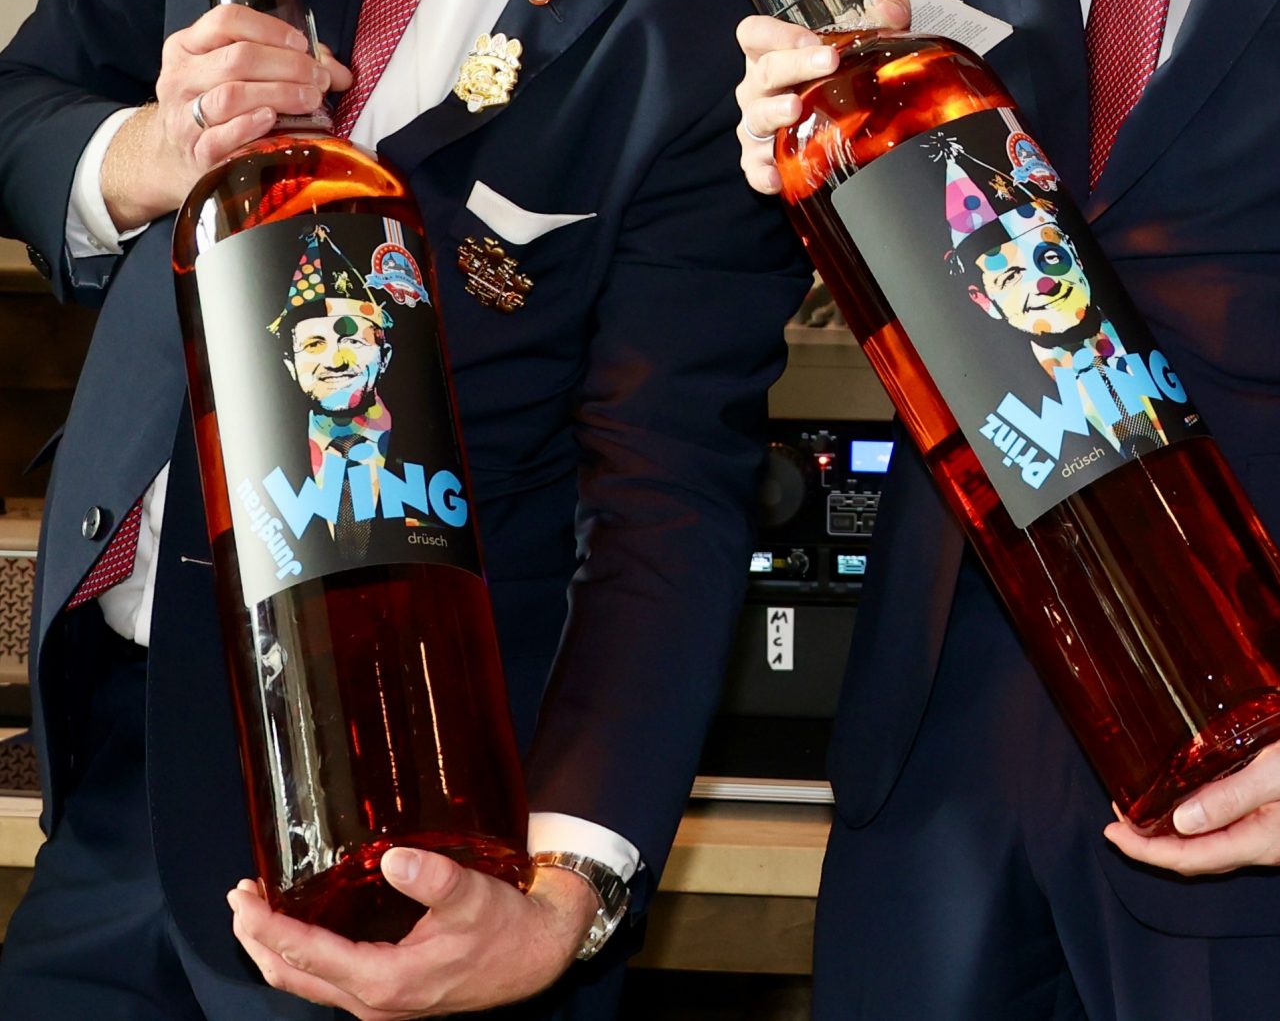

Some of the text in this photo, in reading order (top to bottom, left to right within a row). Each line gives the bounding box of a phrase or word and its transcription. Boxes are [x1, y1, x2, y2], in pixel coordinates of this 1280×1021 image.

[978, 412, 1056, 491] Prinz
[1060, 446, 1106, 479] drüsch
[235, 477, 303, 580] Jungfrau
[407, 531, 448, 548] drüsch
